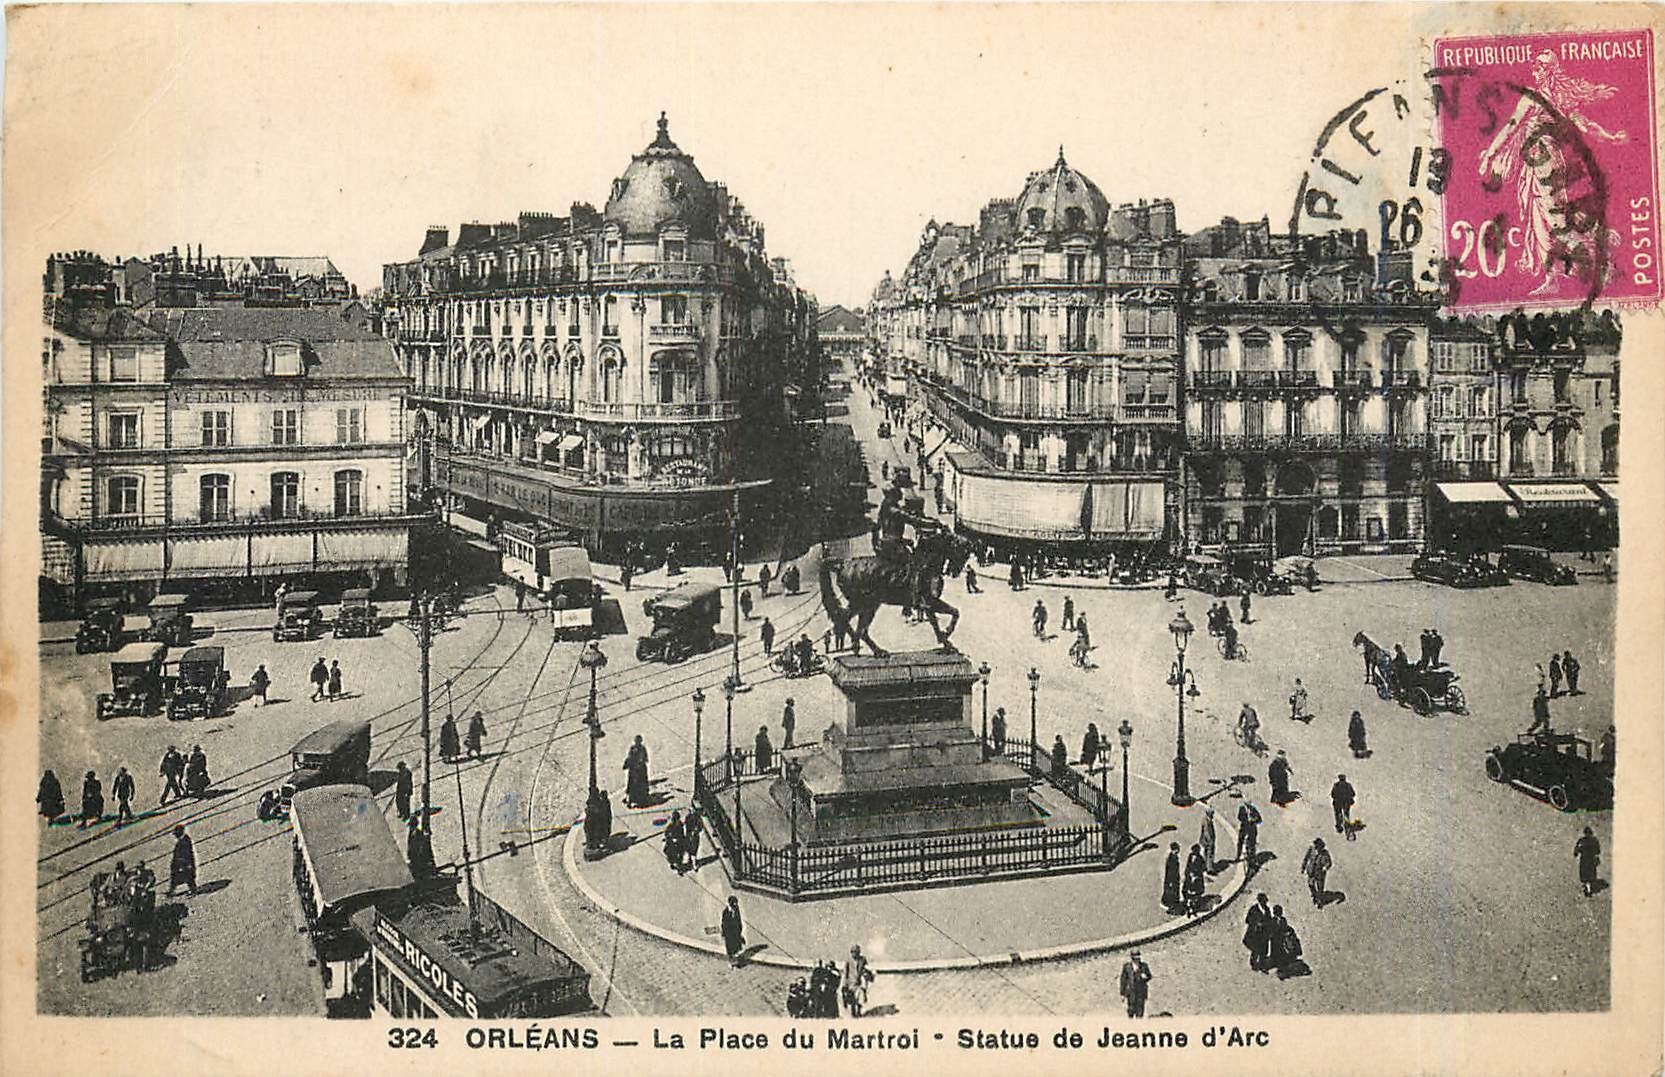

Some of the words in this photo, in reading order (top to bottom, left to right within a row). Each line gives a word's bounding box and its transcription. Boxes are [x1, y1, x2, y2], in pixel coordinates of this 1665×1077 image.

[1443, 45, 1532, 67] REPUBLIQUE
[1561, 39, 1643, 61] FRANÇAISE
[1450, 219, 1506, 278] 20
[1630, 196, 1652, 286] POSTES
